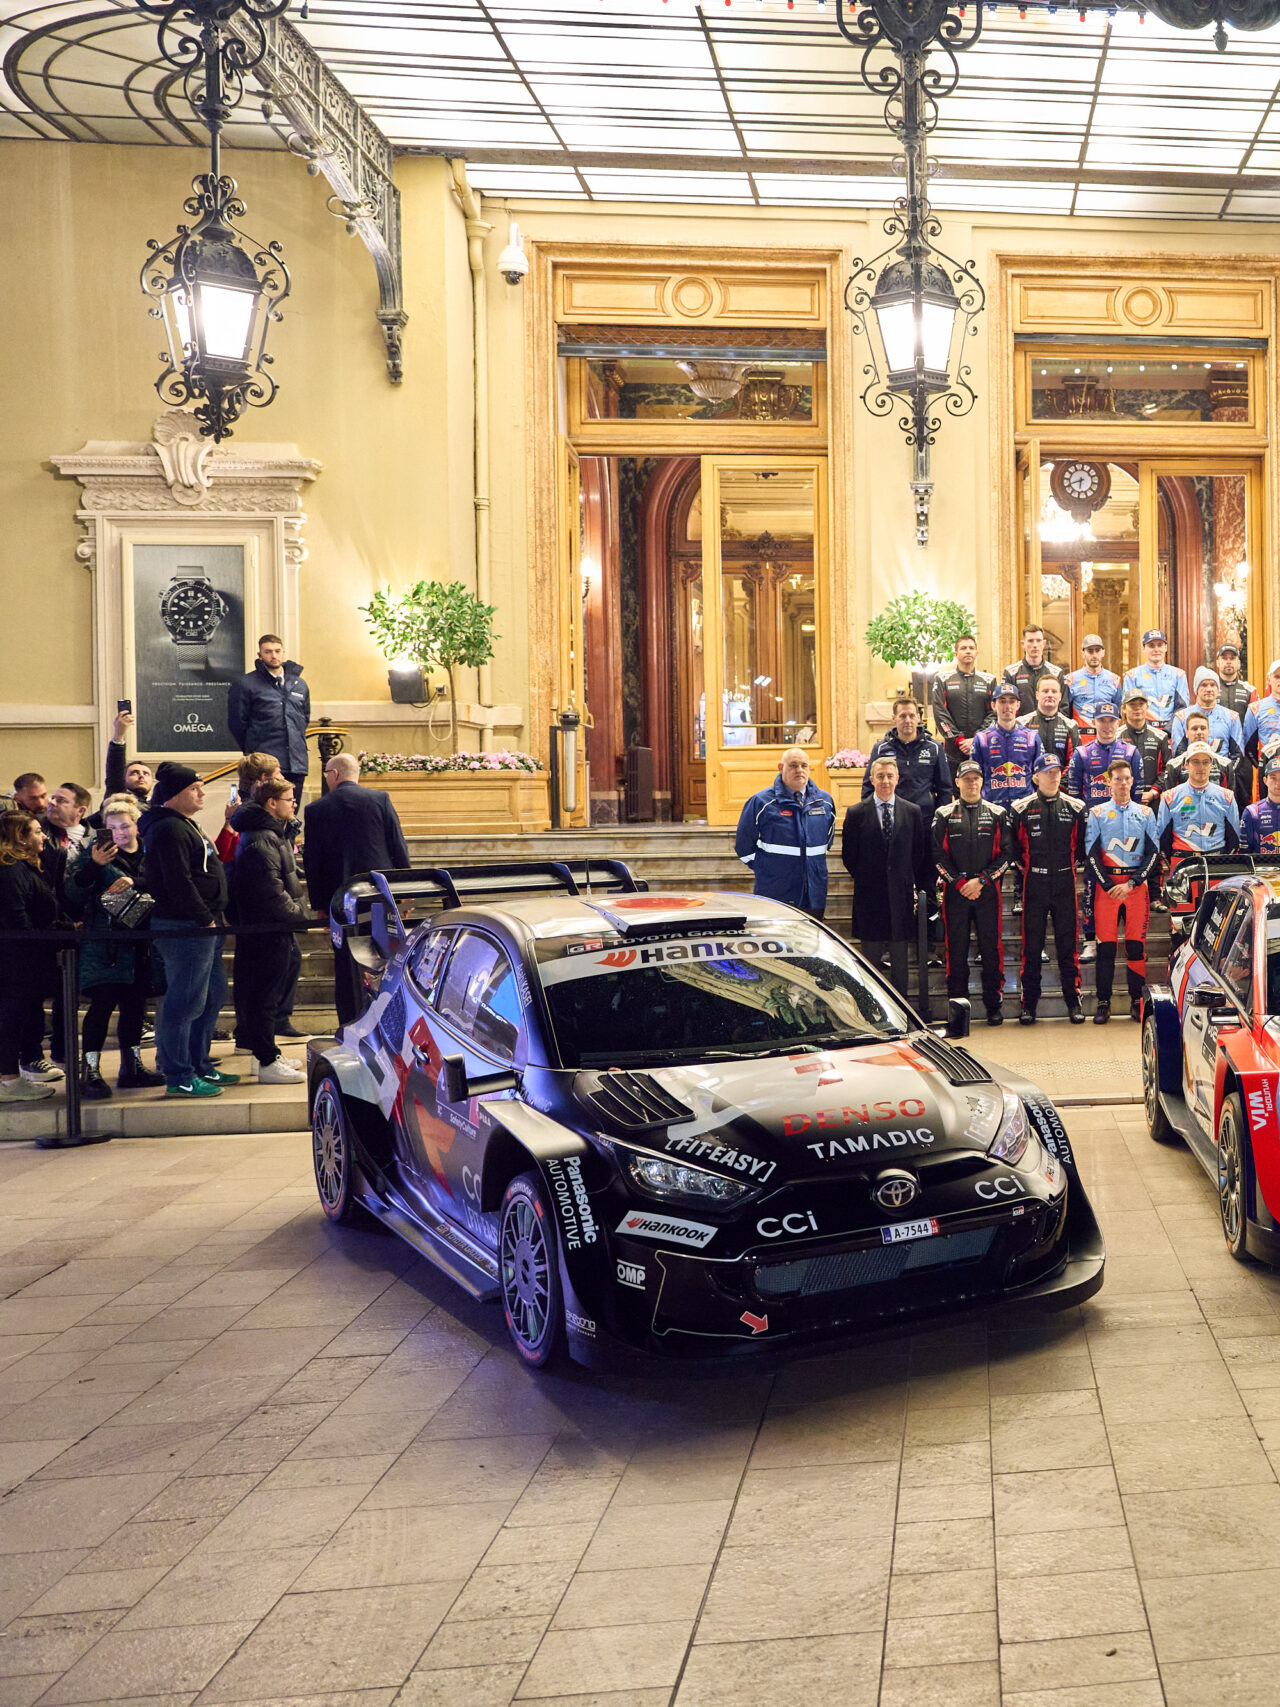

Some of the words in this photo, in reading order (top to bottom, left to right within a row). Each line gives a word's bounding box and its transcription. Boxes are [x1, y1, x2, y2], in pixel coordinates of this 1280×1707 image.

[173, 723, 214, 733] OMEGA
[990, 777, 1008, 789] Red
[1009, 777, 1027, 788] Bull
[569, 939, 602, 954] GR
[609, 932, 683, 946] TOYOTA
[687, 929, 752, 937] GAZOO
[1261, 1078, 1274, 1111] HYUNDAI
[782, 1098, 926, 1136] DENSO
[807, 1127, 935, 1159] TAMADIC
[664, 1137, 777, 1183] [FIT-EASY]
[563, 1155, 600, 1244] Panasonic
[974, 1174, 1026, 1200] CCi
[546, 1159, 582, 1250] AUTOMOTIVE
[756, 1210, 819, 1238] CCi
[894, 1222, 930, 1240] A-7544
[616, 1262, 646, 1286] OMP
